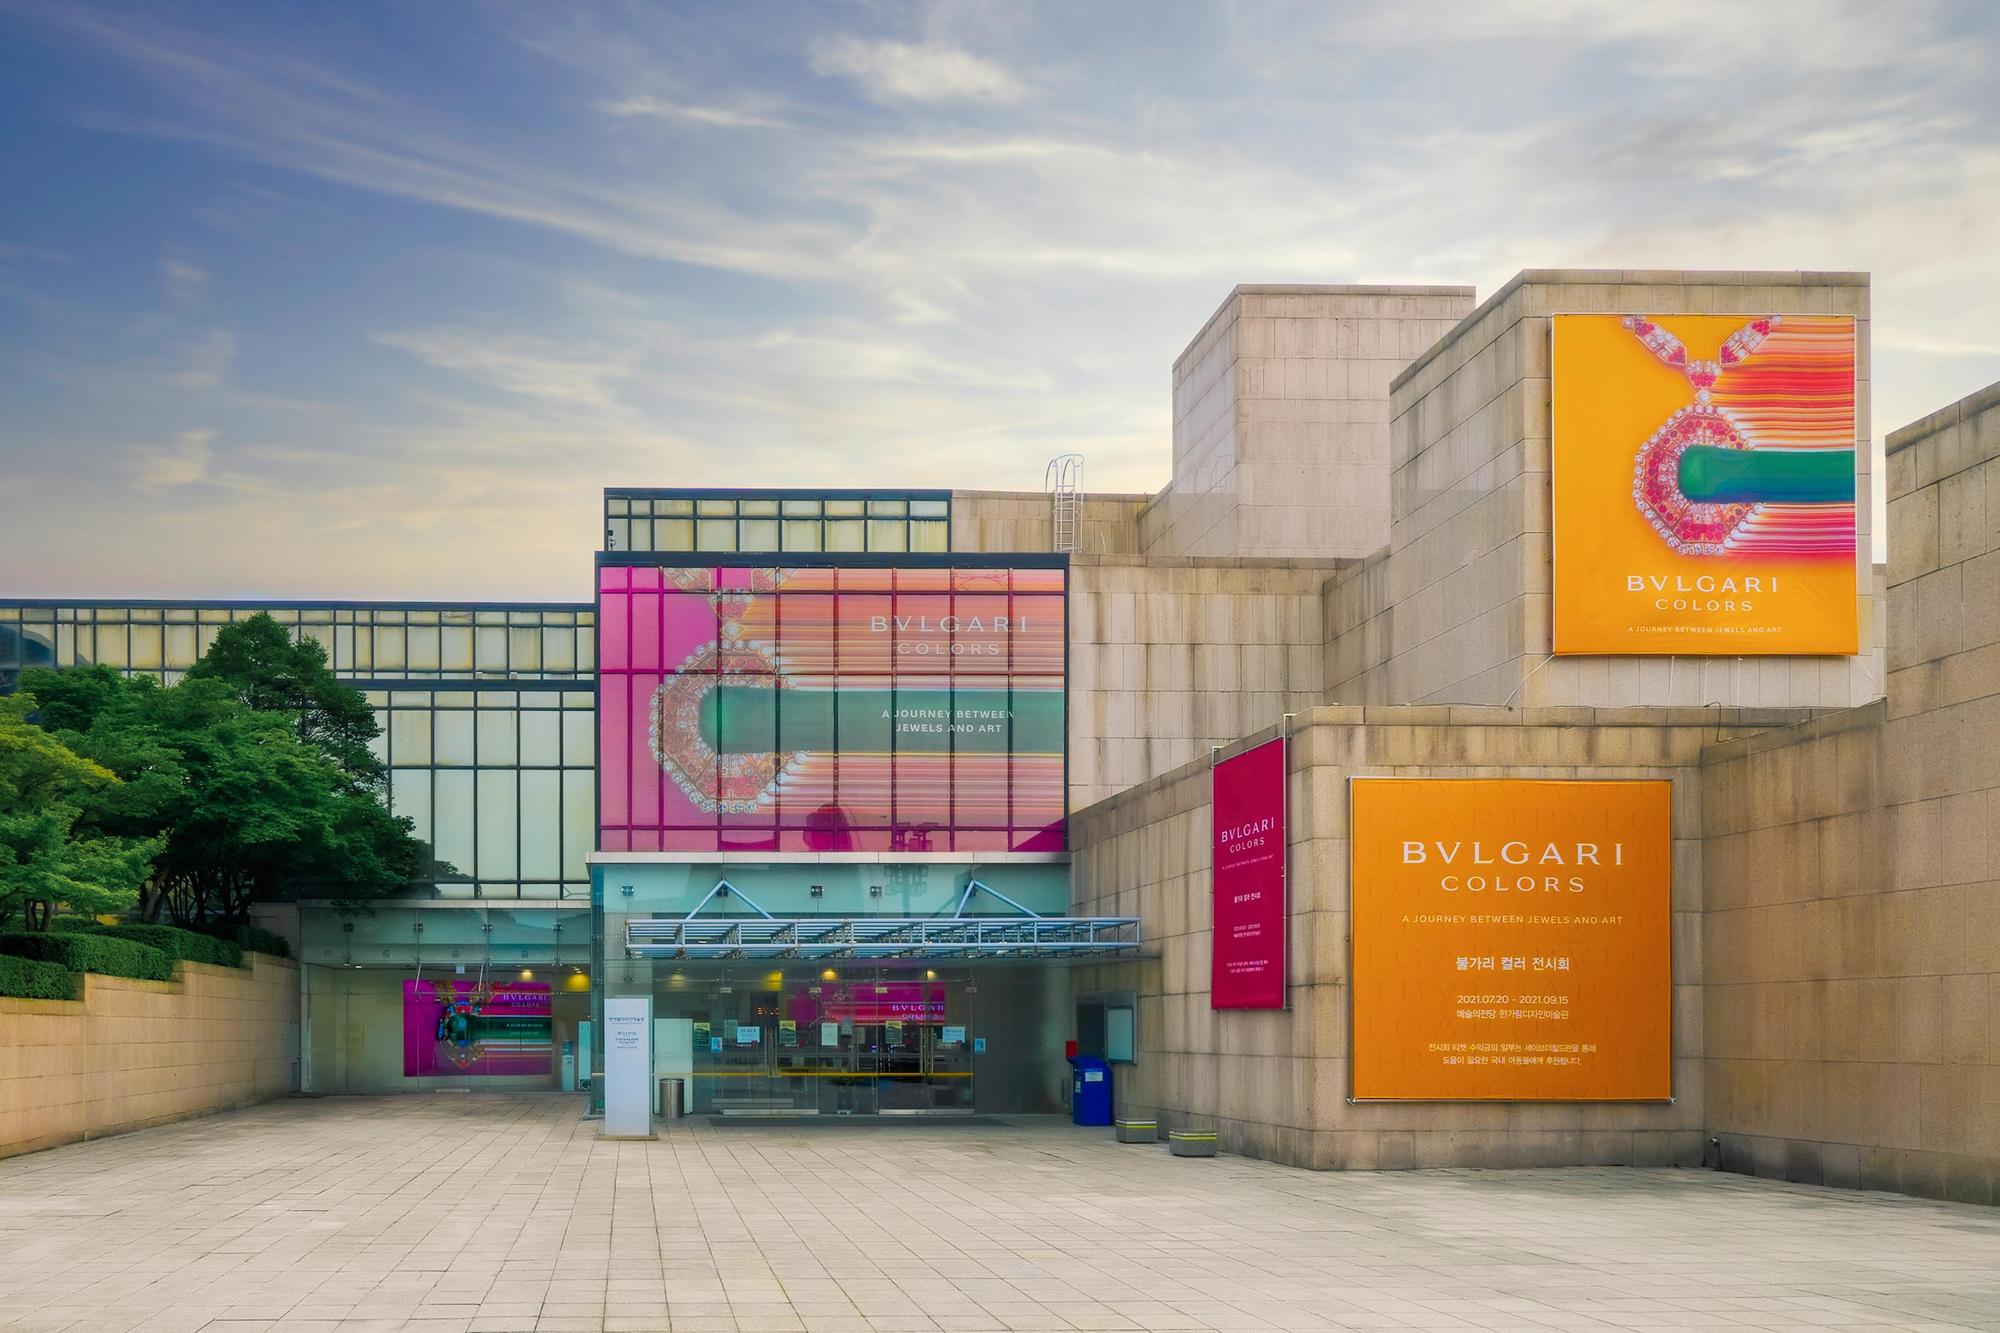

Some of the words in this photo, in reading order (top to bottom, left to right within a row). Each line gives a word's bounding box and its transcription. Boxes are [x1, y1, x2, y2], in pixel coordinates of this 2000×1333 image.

[1627, 575, 1778, 593] BVLGARI
[1655, 598, 1753, 612] COLORS
[870, 615, 1027, 633] BVLGARI
[896, 643, 1001, 655] COLORS
[882, 710, 890, 719] A
[894, 710, 951, 719] JOURNEY
[896, 724, 943, 733] JEWELS
[947, 724, 974, 733] AND
[978, 724, 1002, 733] ART
[1221, 816, 1274, 843] BVLGARI
[1229, 837, 1265, 853] COLORS
[1402, 840, 1624, 866] BVLGARI
[1441, 875, 1585, 893] COLORS
[1402, 914, 1410, 922] A
[1413, 914, 1467, 924] JOURNEY
[1470, 915, 1524, 924] BETWEEN
[1527, 915, 1571, 924] JEWELS
[1574, 916, 1598, 924] AND
[1601, 916, 1624, 925] ART
[1455, 956, 1495, 971] 불가리
[1500, 956, 1527, 971] 컬러
[1531, 956, 1570, 972] 전시회
[1457, 995, 1509, 1004] 2021.07.20
[1519, 995, 1569, 1005] 2021.09.15
